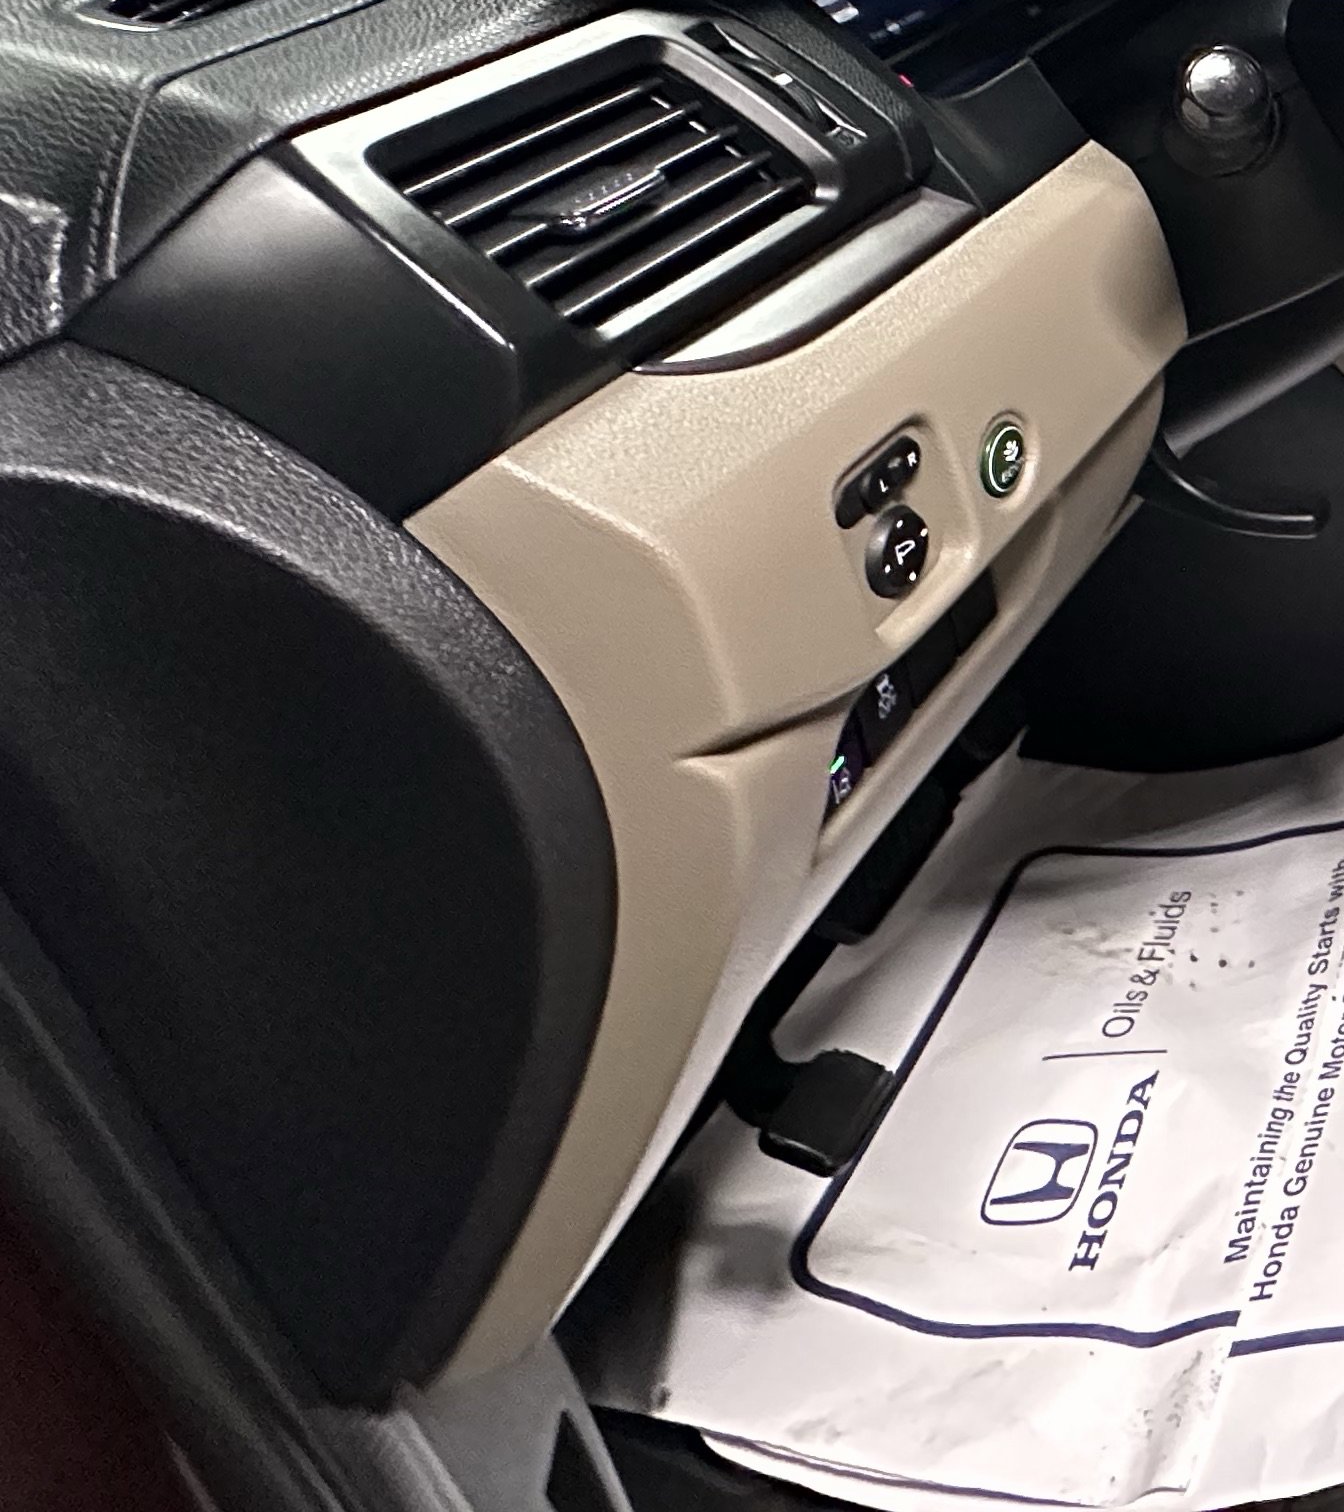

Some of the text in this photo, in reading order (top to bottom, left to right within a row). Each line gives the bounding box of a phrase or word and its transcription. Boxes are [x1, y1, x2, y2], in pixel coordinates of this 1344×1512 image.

[879, 479, 888, 492] L
[907, 451, 917, 466] R
[1102, 890, 1192, 1038] Oils & Fluids
[1308, 907, 1340, 975] Starts
[1285, 984, 1328, 1065] Quality
[1272, 1072, 1300, 1102] the
[1068, 1070, 1160, 1271] HONDA
[1223, 1107, 1294, 1264] Maintaining
[1249, 1205, 1300, 1302] Honda
[1283, 1087, 1335, 1196] Genuine
